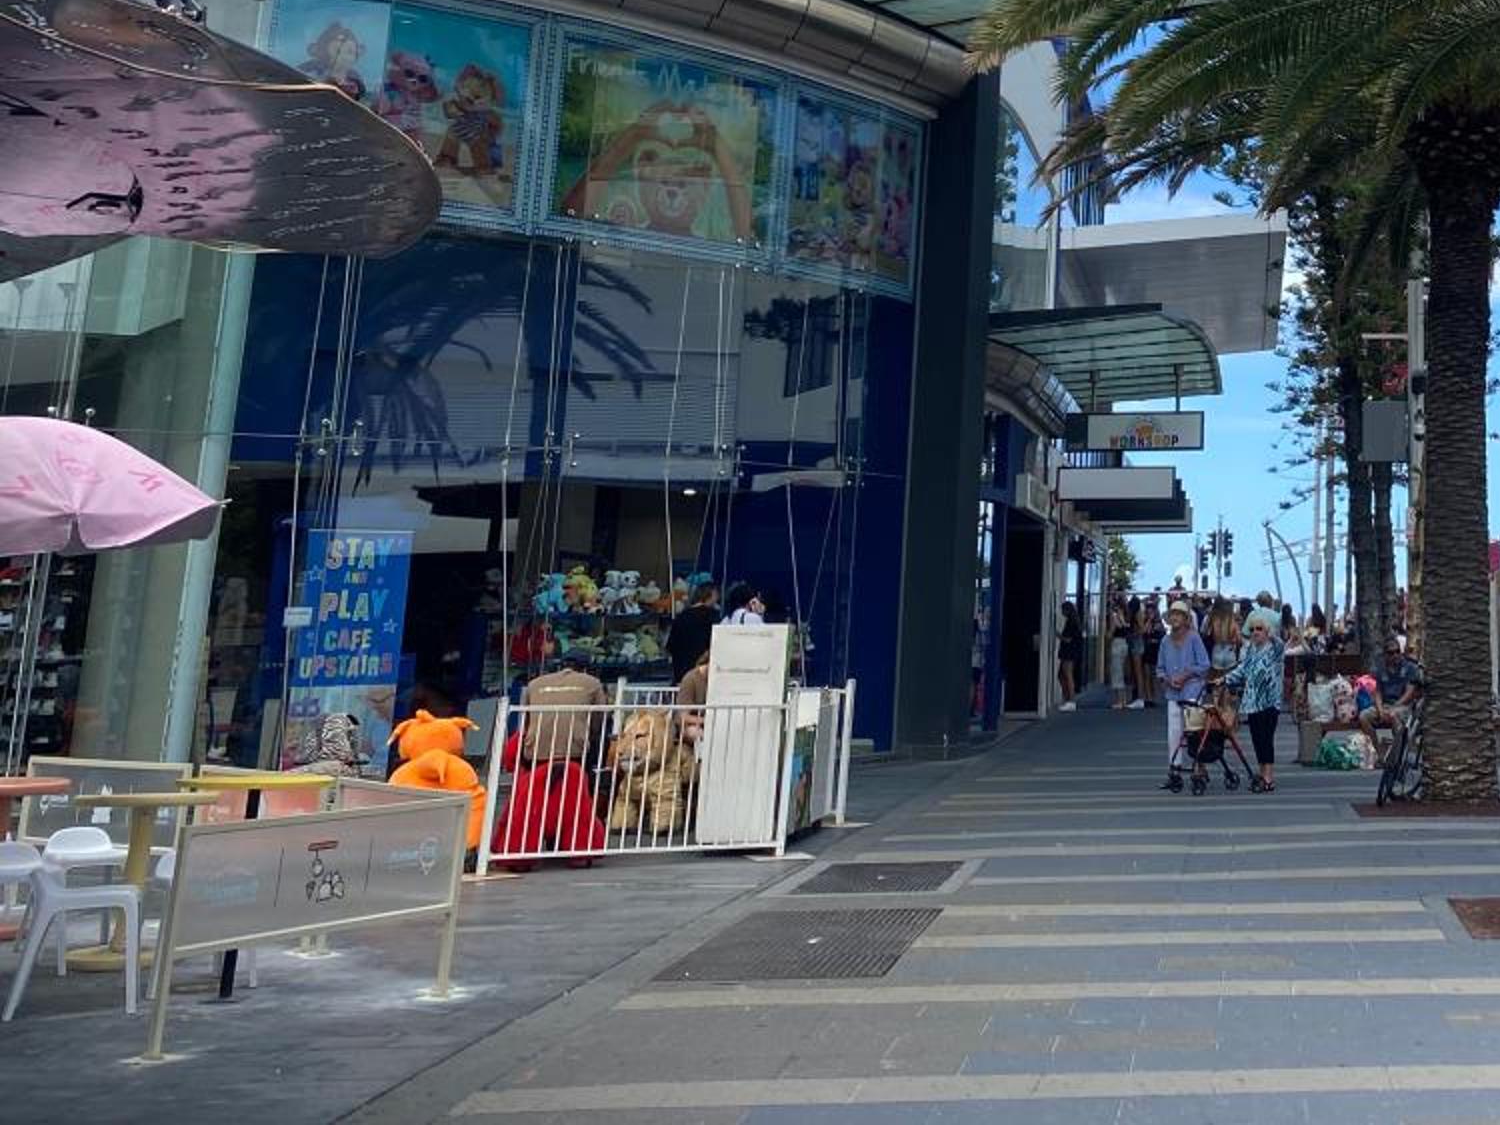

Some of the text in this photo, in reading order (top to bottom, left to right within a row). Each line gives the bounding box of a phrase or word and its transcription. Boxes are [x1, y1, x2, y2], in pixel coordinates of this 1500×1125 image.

[1109, 434, 1179, 448] WORKSHOP
[326, 538, 392, 570] STAY
[319, 588, 390, 623] PLAY
[324, 628, 373, 652] CAFE
[299, 652, 394, 680] UPSTAIRS
